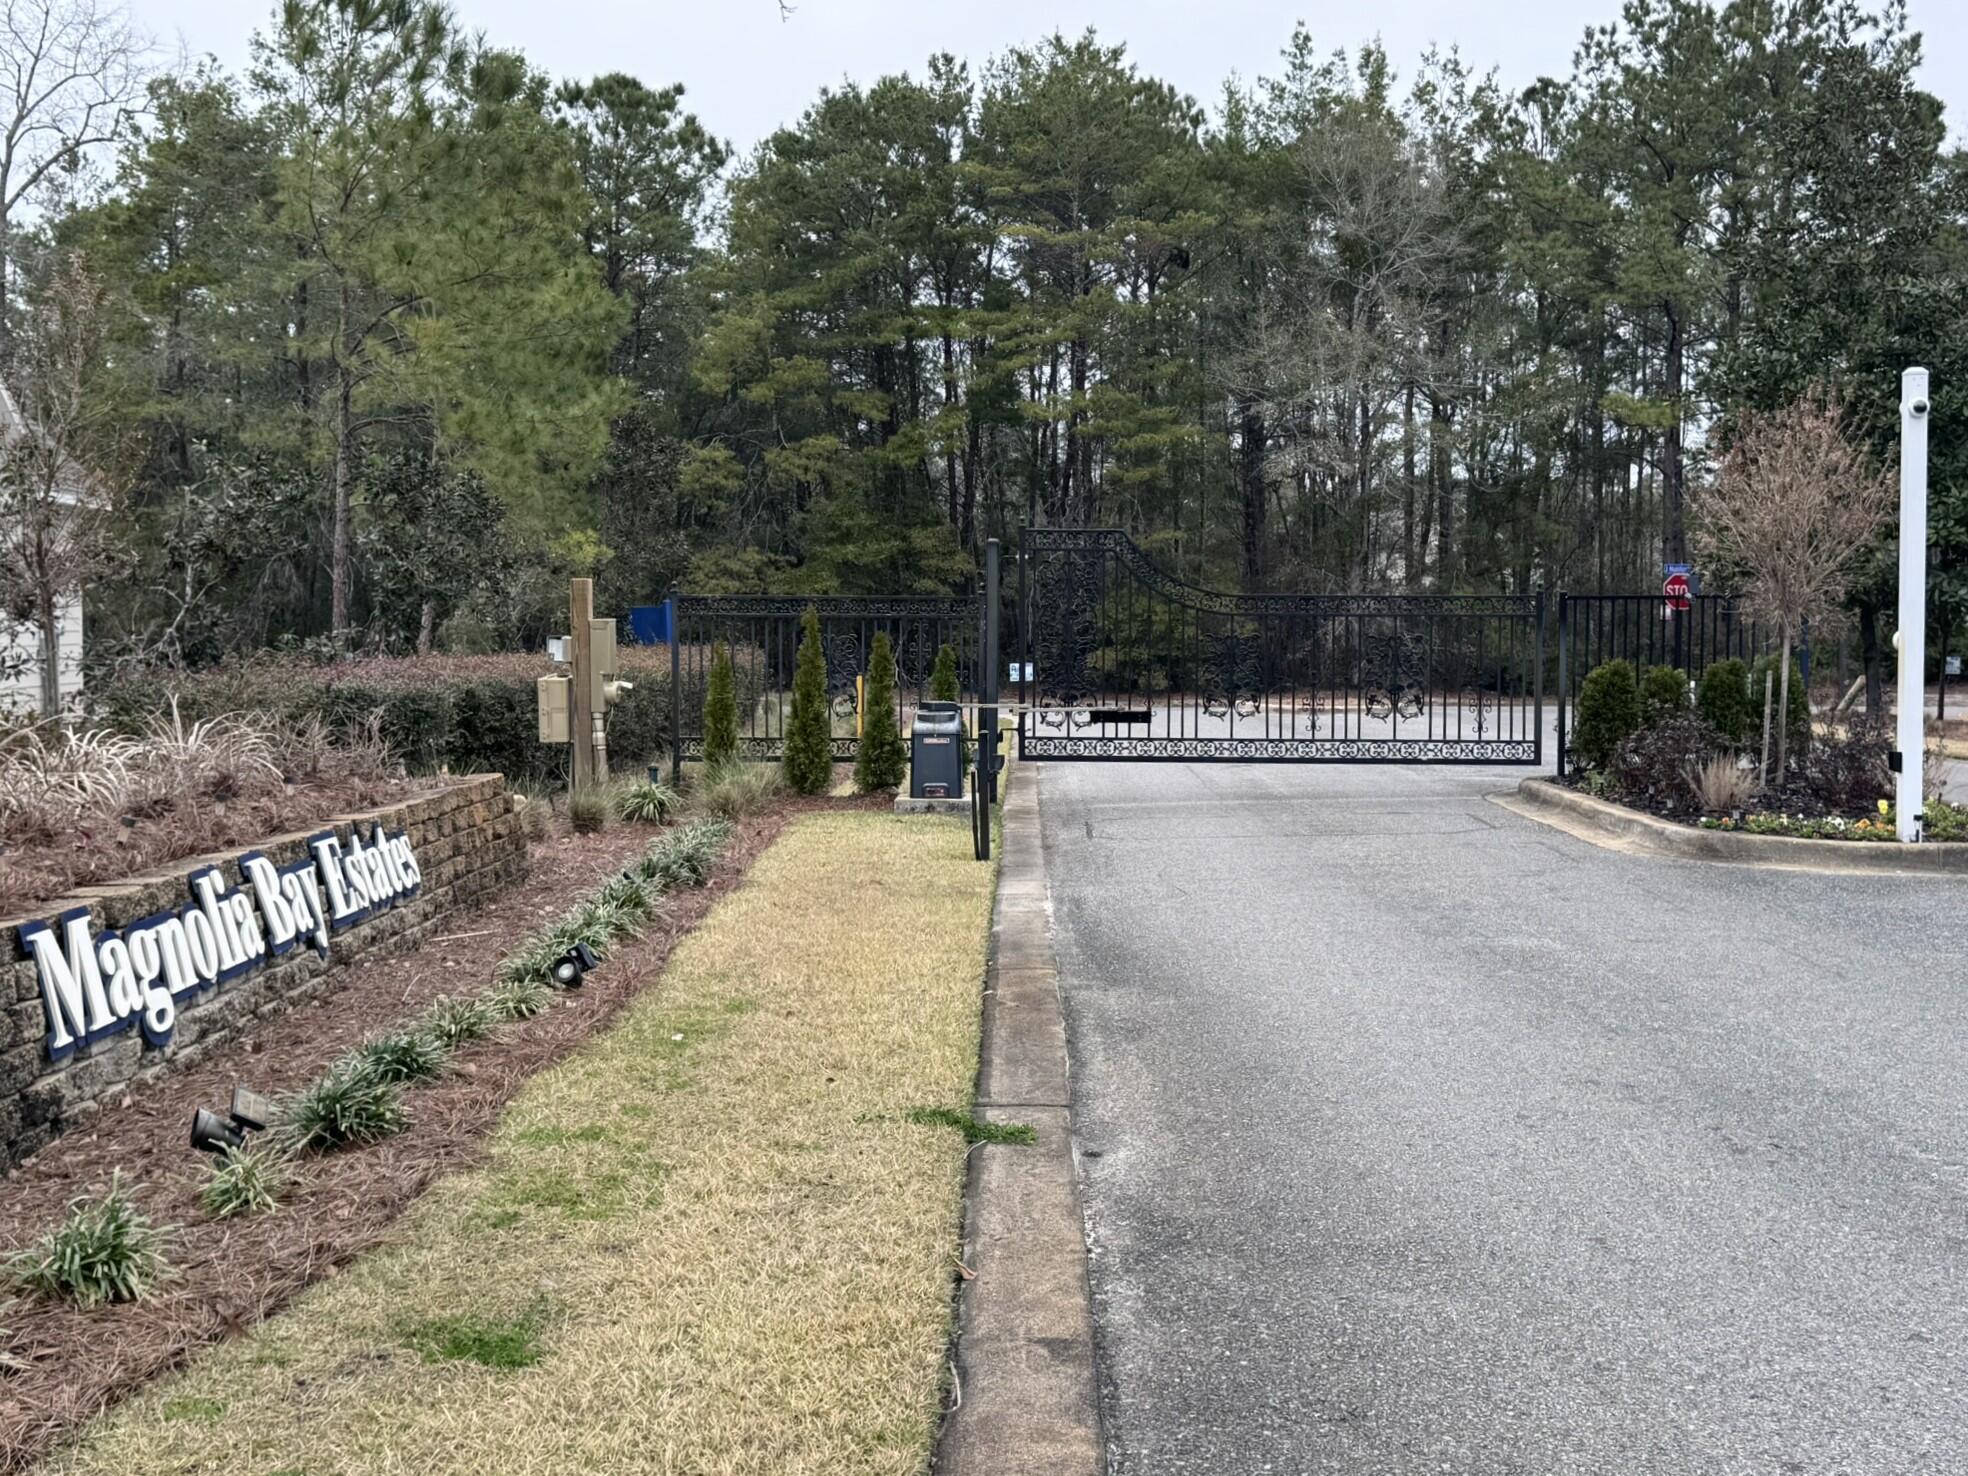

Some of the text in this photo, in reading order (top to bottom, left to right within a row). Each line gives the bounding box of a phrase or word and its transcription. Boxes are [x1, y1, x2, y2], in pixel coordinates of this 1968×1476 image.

[1666, 584, 1689, 597] STO
[27, 825, 422, 1049] Magnolia Bay Estates
